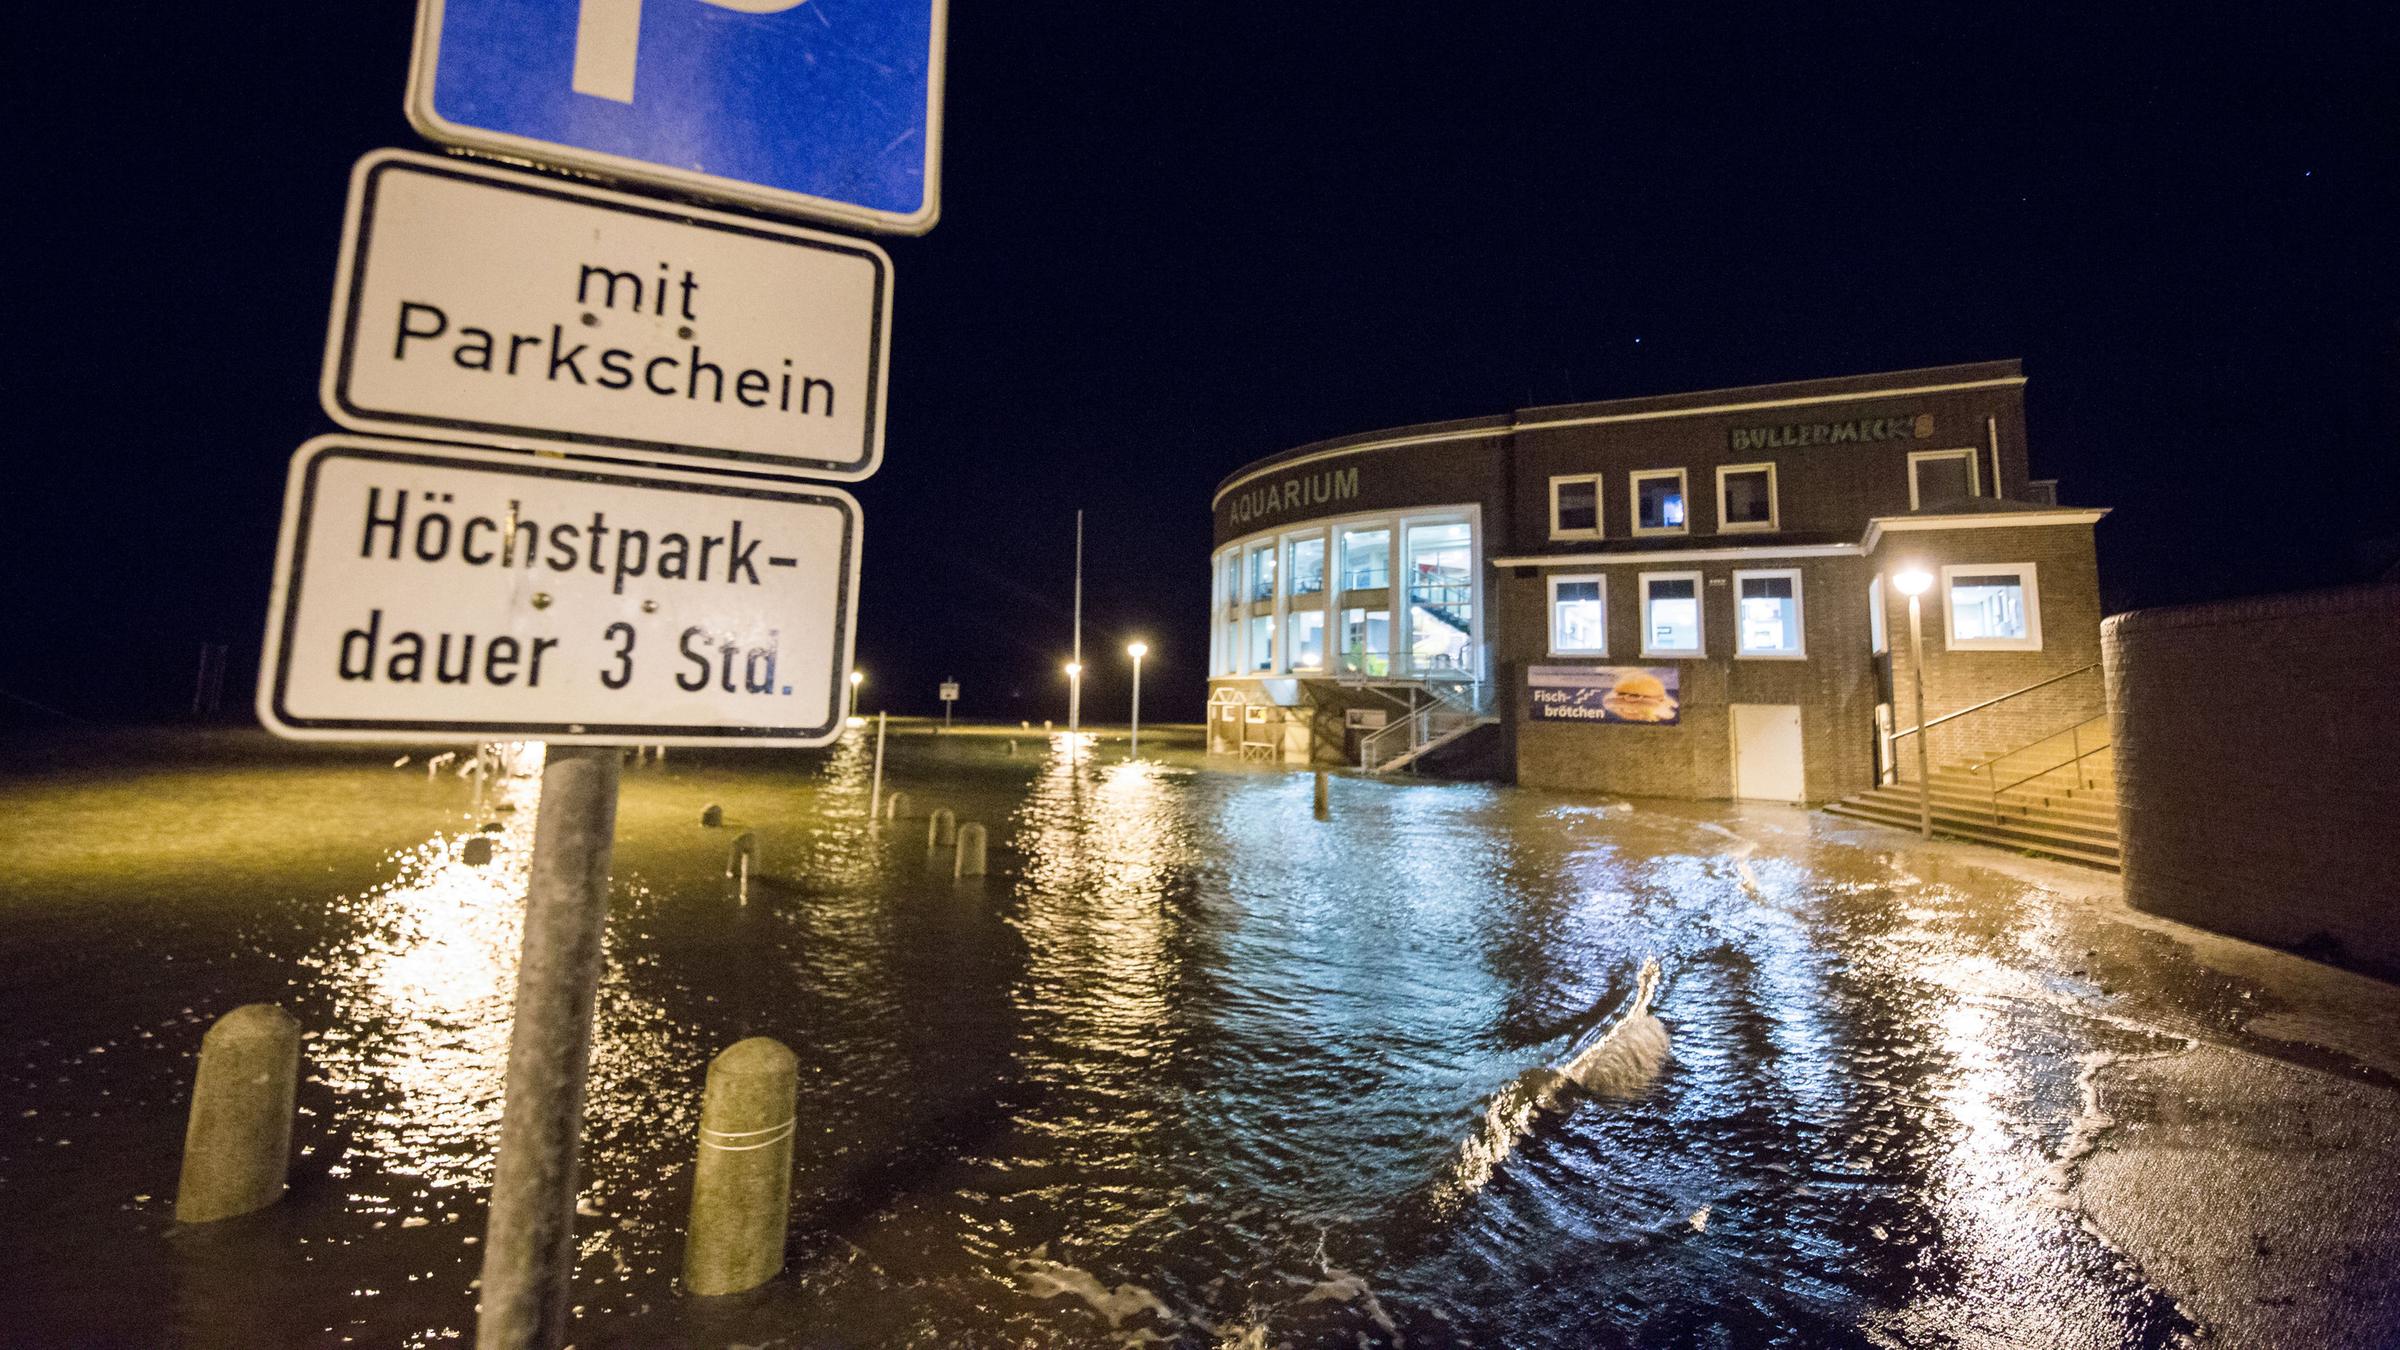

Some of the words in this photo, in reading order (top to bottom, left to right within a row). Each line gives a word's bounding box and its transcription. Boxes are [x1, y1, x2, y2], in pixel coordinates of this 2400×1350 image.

[577, 262, 699, 321] mit
[394, 301, 836, 417] Parkschein
[1230, 467, 1359, 527] AQUARIUM
[360, 487, 798, 595] Höchstpark-
[337, 609, 558, 688] dauer
[600, 622, 637, 690] 3
[676, 626, 794, 695] Std.
[1534, 690, 1571, 702] Fisch-
[1544, 705, 1605, 719] brötchen
